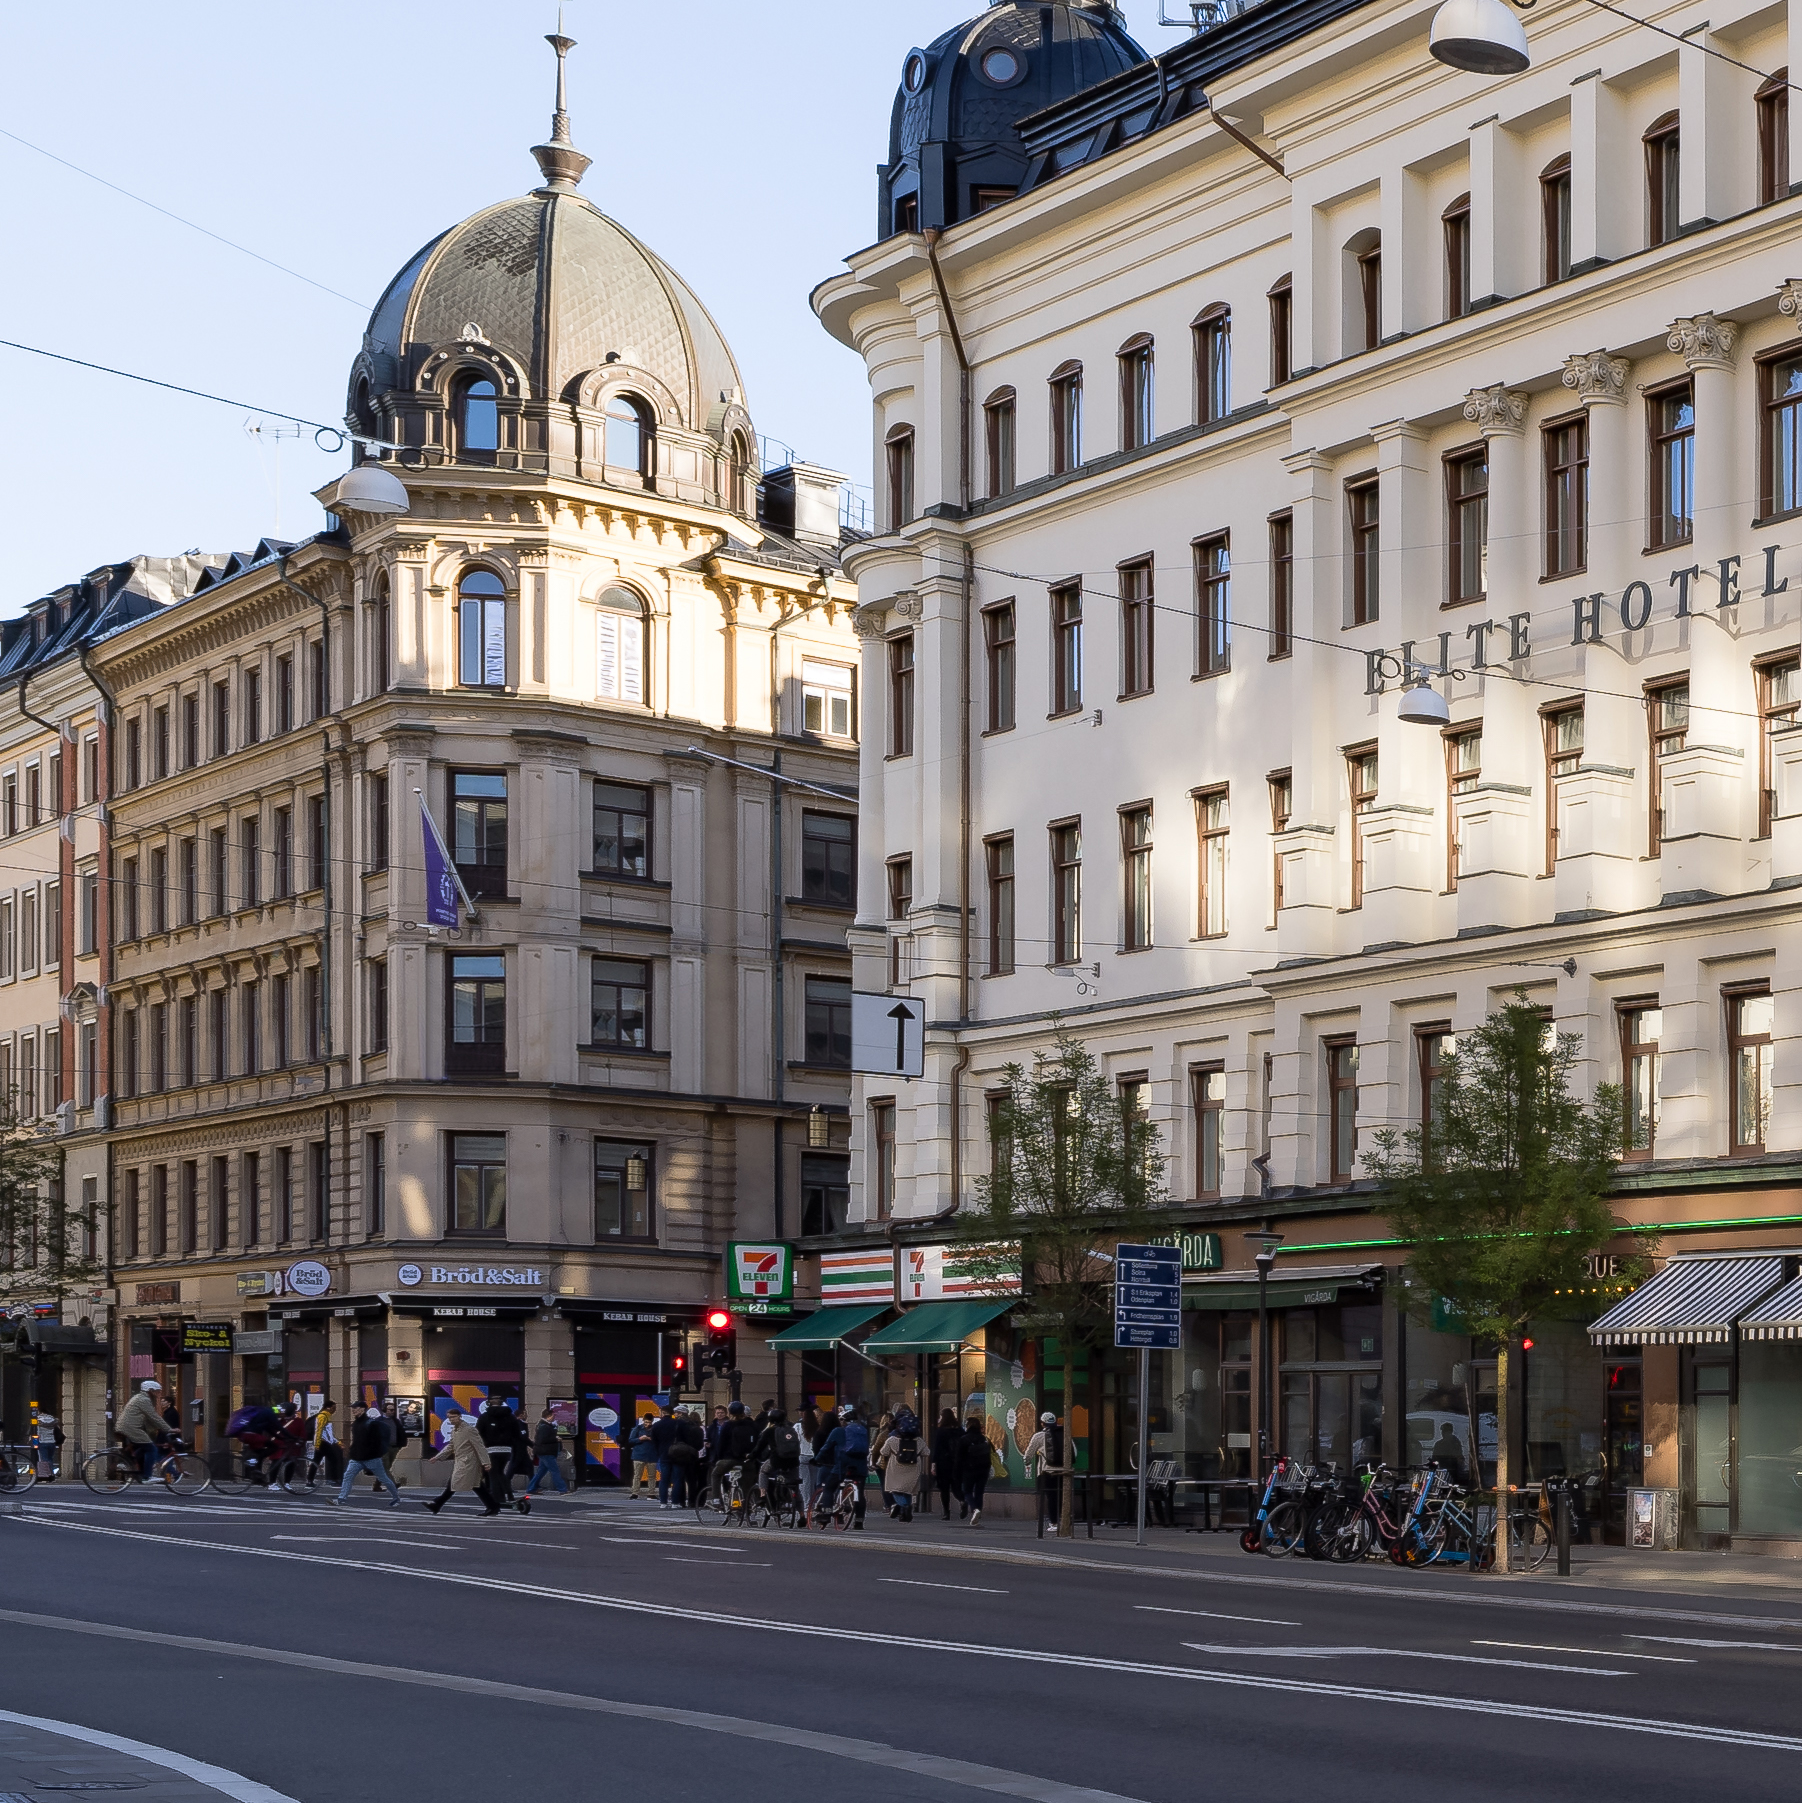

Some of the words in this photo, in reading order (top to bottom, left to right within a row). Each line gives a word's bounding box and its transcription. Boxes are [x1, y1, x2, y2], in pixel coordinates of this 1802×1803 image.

[1364, 612, 1532, 695] ELITE
[1570, 544, 1789, 646] HOTEL
[296, 1269, 323, 1278] Bröd
[744, 1252, 777, 1294] 7
[1581, 1255, 1618, 1279] QUE
[430, 1267, 542, 1285] Bröd&Salt
[433, 1308, 463, 1316] KEBAB
[751, 1304, 766, 1313] 24
[769, 1305, 790, 1313] HOURS
[603, 1313, 633, 1321] KEBAB
[637, 1314, 667, 1323] HOUSE
